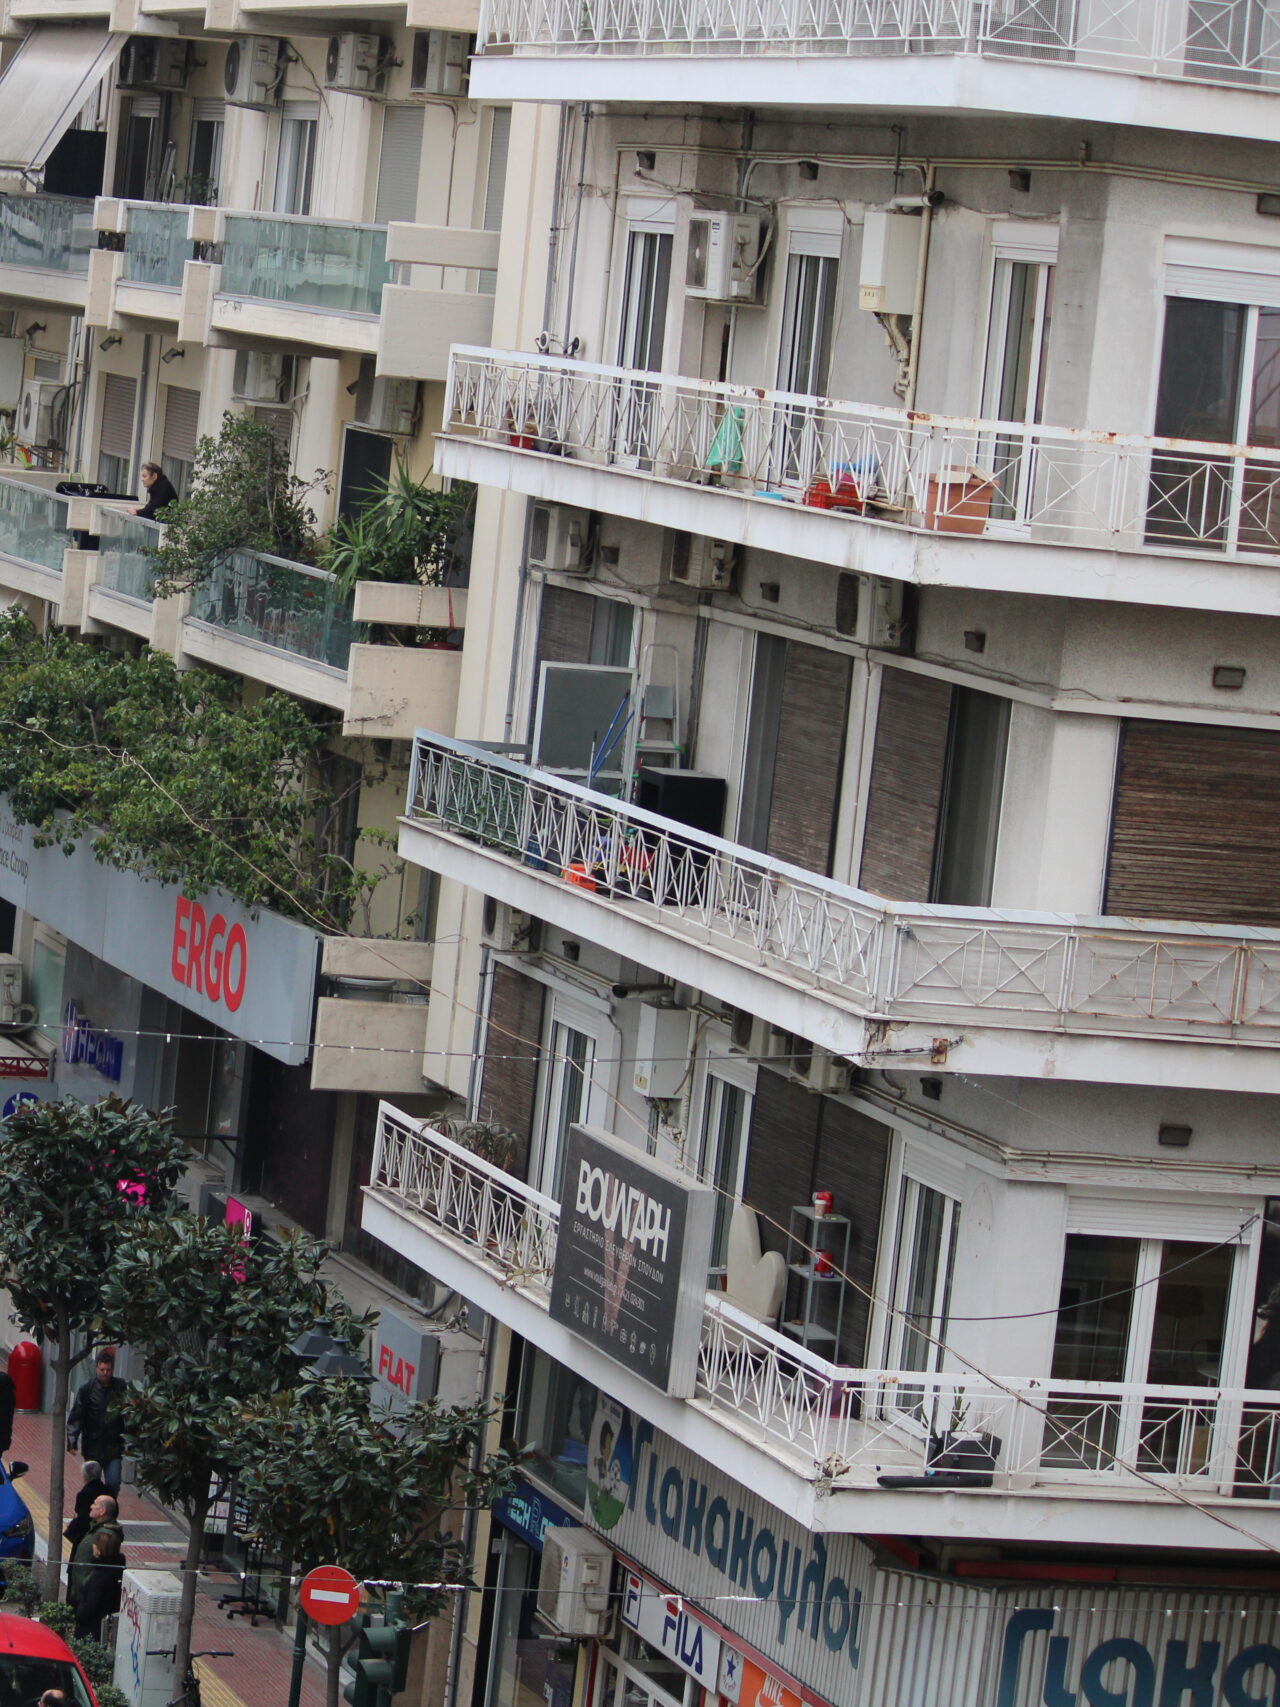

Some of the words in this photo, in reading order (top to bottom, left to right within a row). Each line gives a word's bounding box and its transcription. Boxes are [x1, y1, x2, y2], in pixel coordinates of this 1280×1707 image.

[10, 850, 29, 885] Group
[170, 894, 248, 1012] ERGO
[573, 1221, 604, 1249] ΕΡΓΑΣΤΗΡΙΟ
[605, 1240, 637, 1268] ΕΛΕΥΘΕΡΩΝ
[637, 1259, 664, 1285] ΣΠΟΥΔΩΝ
[378, 1343, 415, 1396] FLAT
[662, 1601, 703, 1676] FILA
